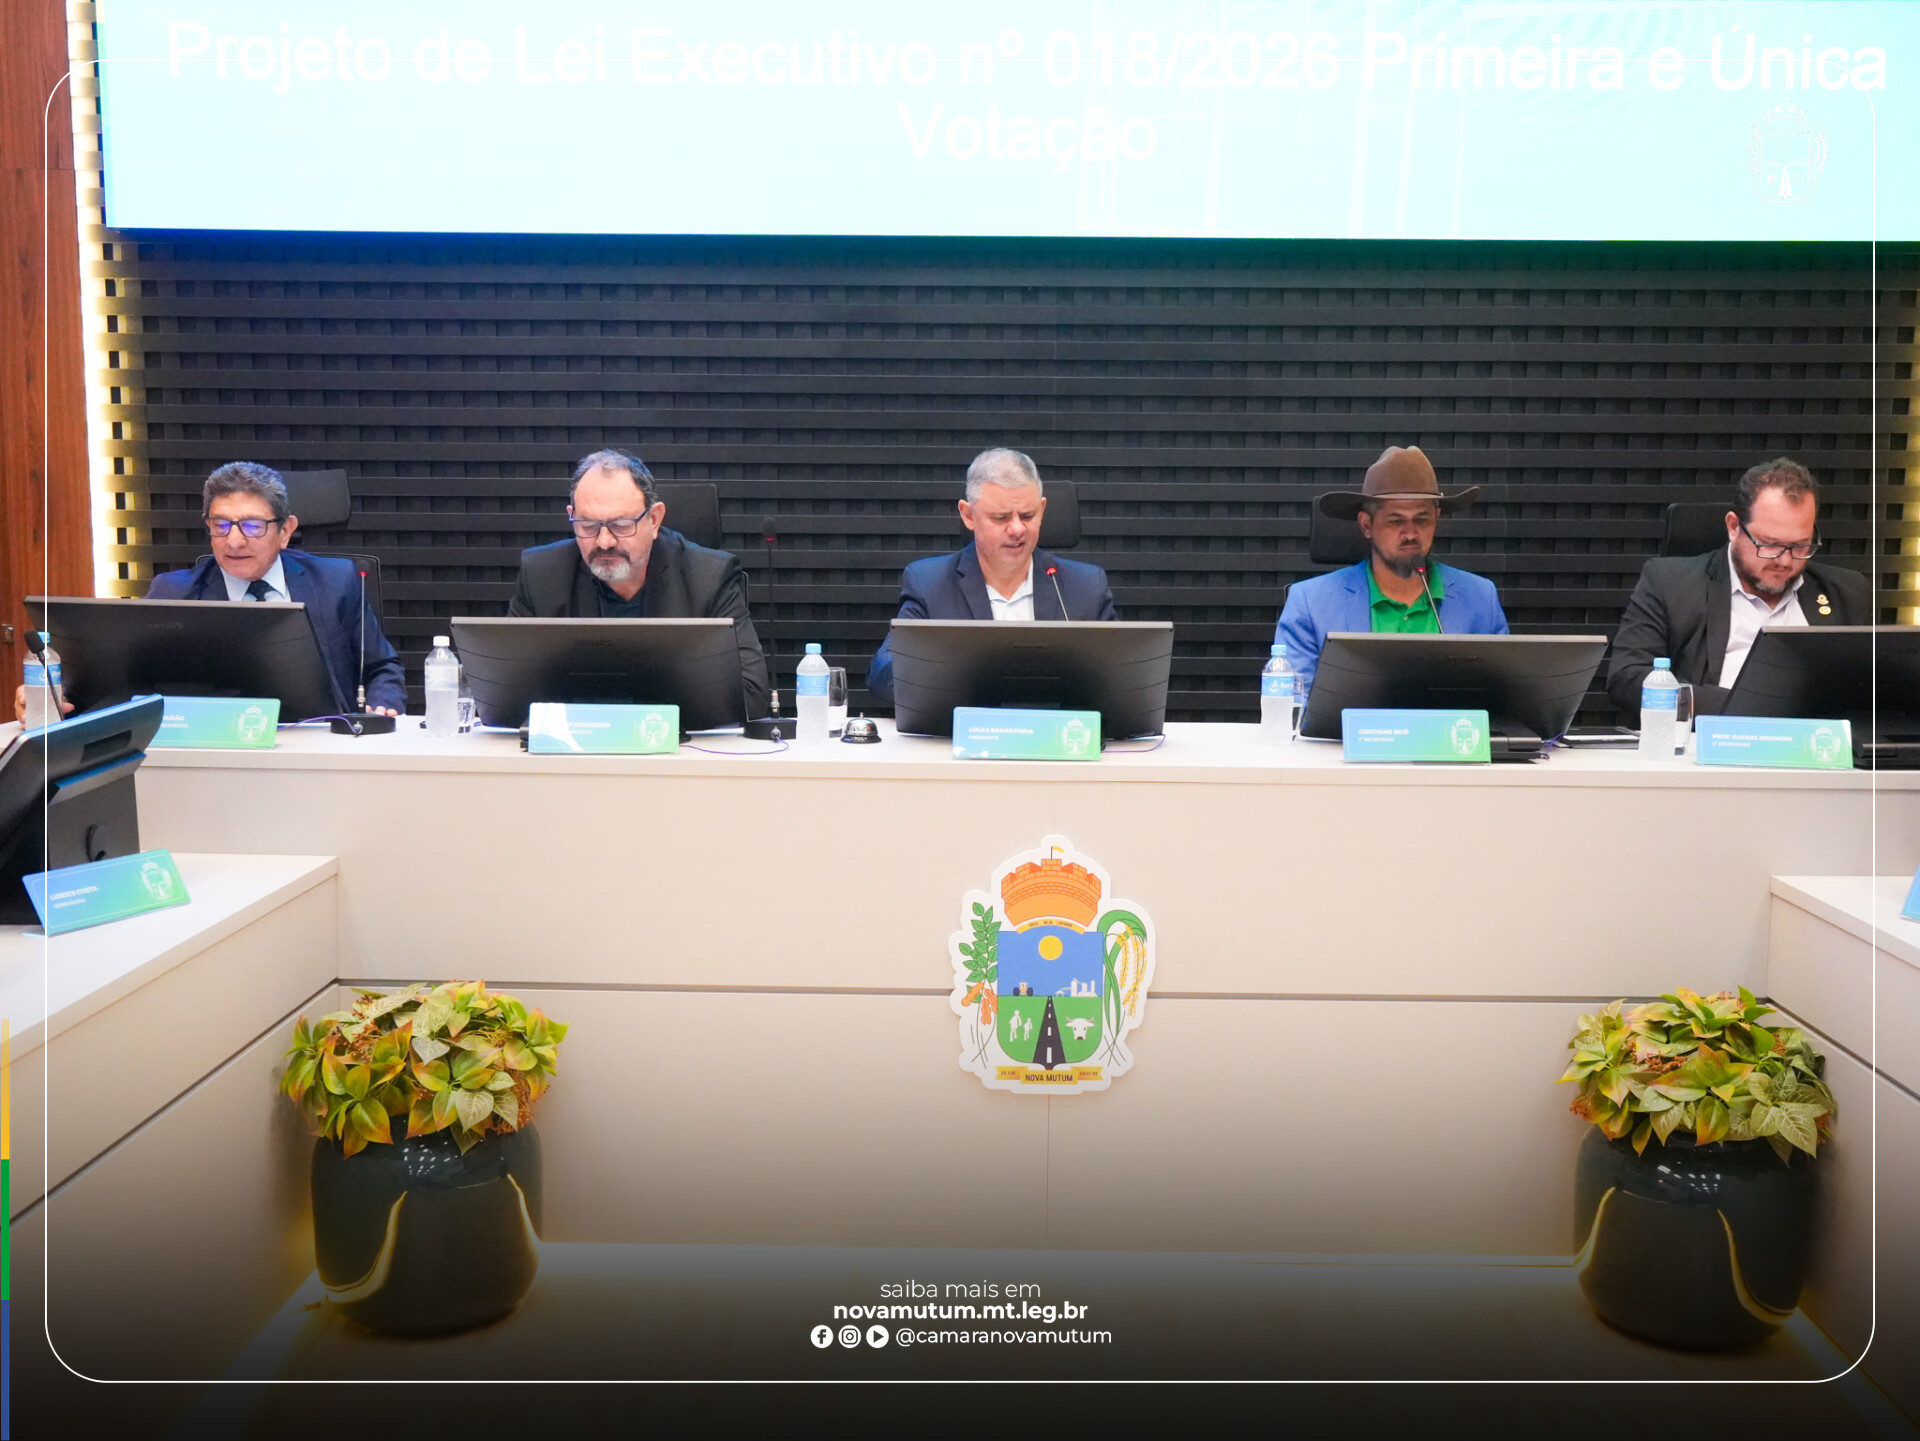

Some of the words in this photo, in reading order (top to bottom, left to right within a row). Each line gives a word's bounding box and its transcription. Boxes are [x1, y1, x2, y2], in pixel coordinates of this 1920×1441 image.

[165, 21, 393, 94] Projeto
[413, 26, 493, 83] de
[514, 26, 608, 85] Lei
[630, 26, 937, 87] Executivo
[1042, 30, 1341, 90] 018/2026
[1362, 31, 1627, 92] Primeira
[1647, 44, 1686, 92] e
[1709, 26, 1888, 92] Única
[897, 101, 1158, 173] Votação
[1046, 1074, 1073, 1082] MUTUM
